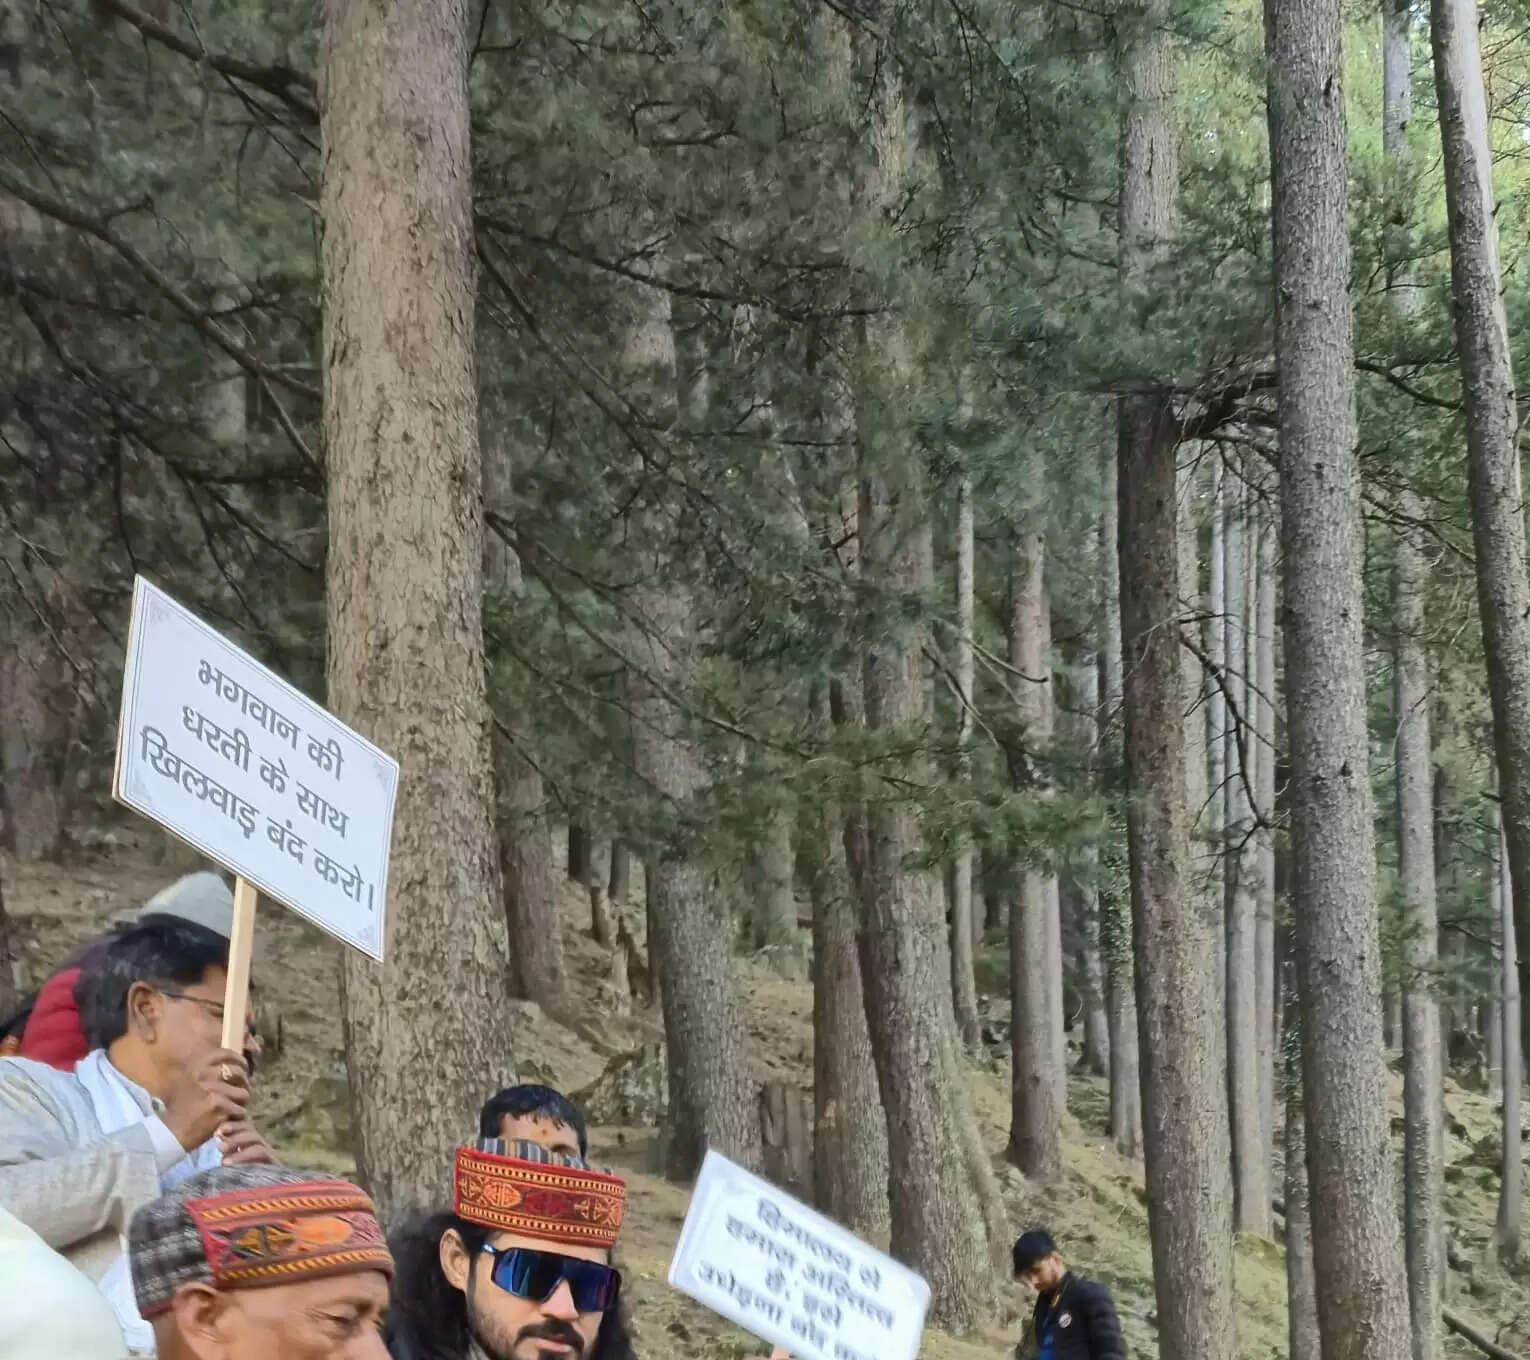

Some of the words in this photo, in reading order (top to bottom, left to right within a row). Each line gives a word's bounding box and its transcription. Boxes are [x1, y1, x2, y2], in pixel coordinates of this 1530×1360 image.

[183, 706, 252, 773] धरती
[260, 756, 289, 793] के
[296, 781, 349, 839] साथ
[198, 660, 301, 751] भगवान
[307, 734, 344, 780] की
[140, 726, 260, 839] खिलवाड़
[267, 817, 307, 864] बंद
[314, 848, 374, 911] करो।
